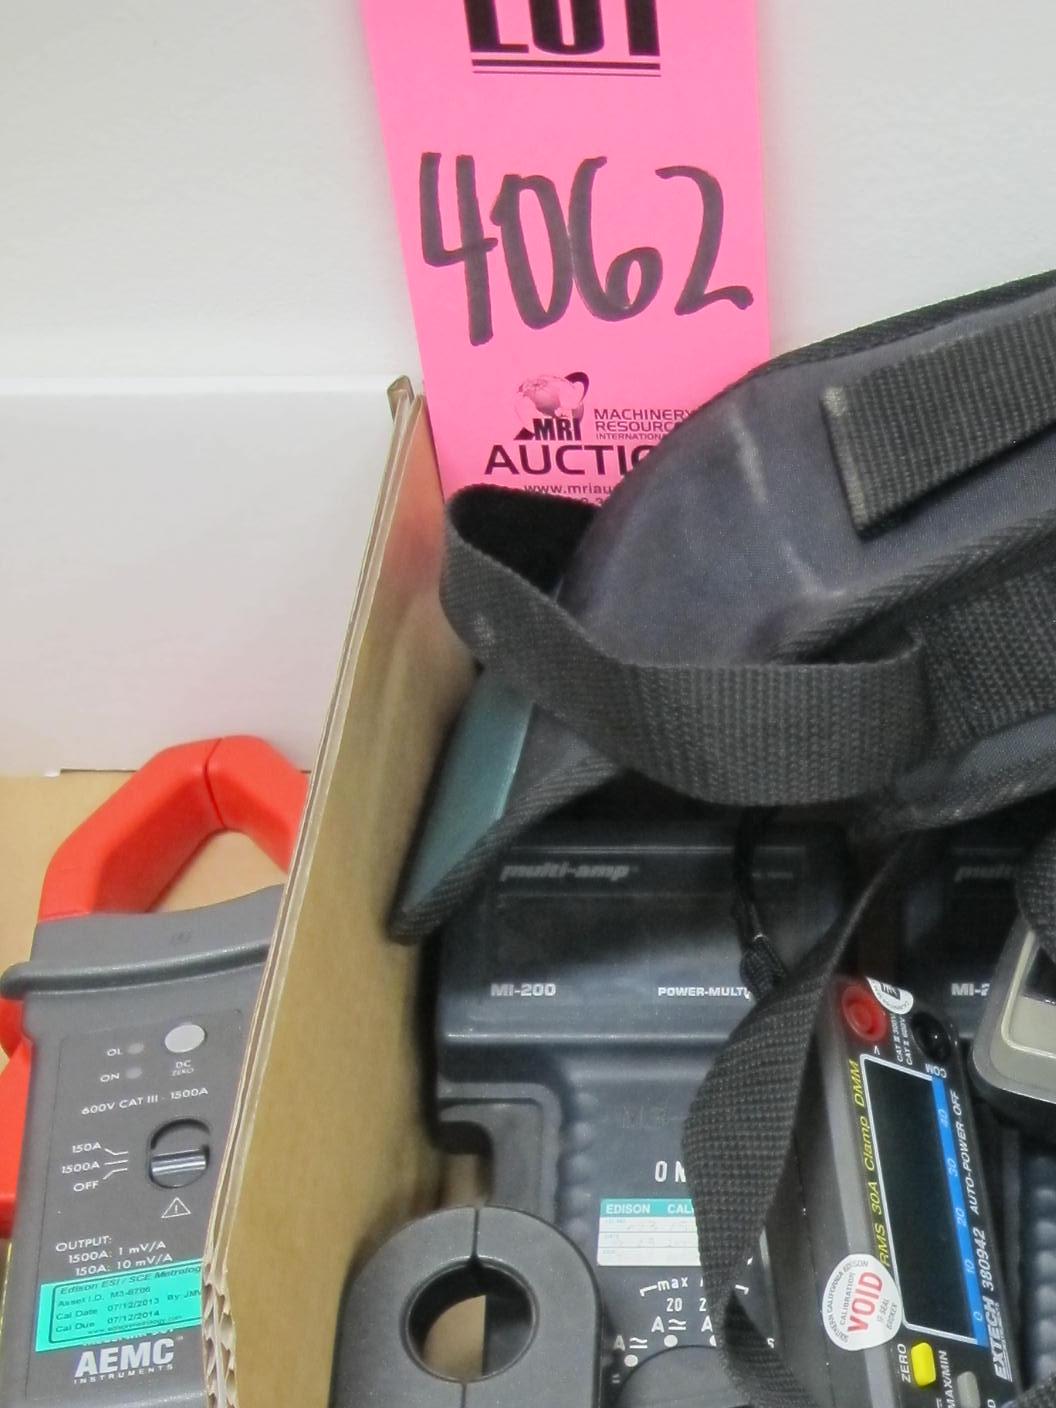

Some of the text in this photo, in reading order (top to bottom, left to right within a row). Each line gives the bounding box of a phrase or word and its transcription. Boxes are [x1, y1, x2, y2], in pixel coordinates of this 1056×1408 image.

[419, 152, 753, 346] 4062
[533, 418, 582, 441] MRI
[595, 421, 675, 433] RESOURC
[523, 483, 613, 494] www.mriau
[490, 982, 557, 997] MI-200
[657, 986, 750, 999] POWER-MULT
[100, 1072, 120, 1083] ON
[925, 1063, 948, 1079] COM
[81, 1102, 115, 1115] 600V
[119, 1096, 144, 1109] CAT
[170, 1087, 209, 1100] 1500A
[950, 1090, 962, 1117] OFF
[72, 1141, 102, 1153] 150A
[62, 1161, 100, 1174] 1500A
[849, 1059, 890, 1268] RMS 30A Clamp DMM
[956, 1120, 980, 1216] AUTO-POWER
[73, 1180, 99, 1192] OFF
[605, 1203, 651, 1214] EDISON
[55, 1235, 112, 1252] OUTPUT:
[68, 1250, 112, 1264] 1500A:
[128, 1240, 167, 1254] mV/A
[75, 1253, 173, 1276] 150A: 10 mV/A
[972, 1226, 995, 1291] 380942
[154, 1266, 202, 1279] Metrolog
[657, 1276, 689, 1292] max
[666, 1297, 683, 1312] 20
[847, 1272, 883, 1332] VOID
[982, 1296, 1006, 1378] EXTECH
[74, 1337, 175, 1378] AEMC
[897, 1343, 911, 1383] ZERO
[73, 1364, 174, 1384] INSTRUMENTS
